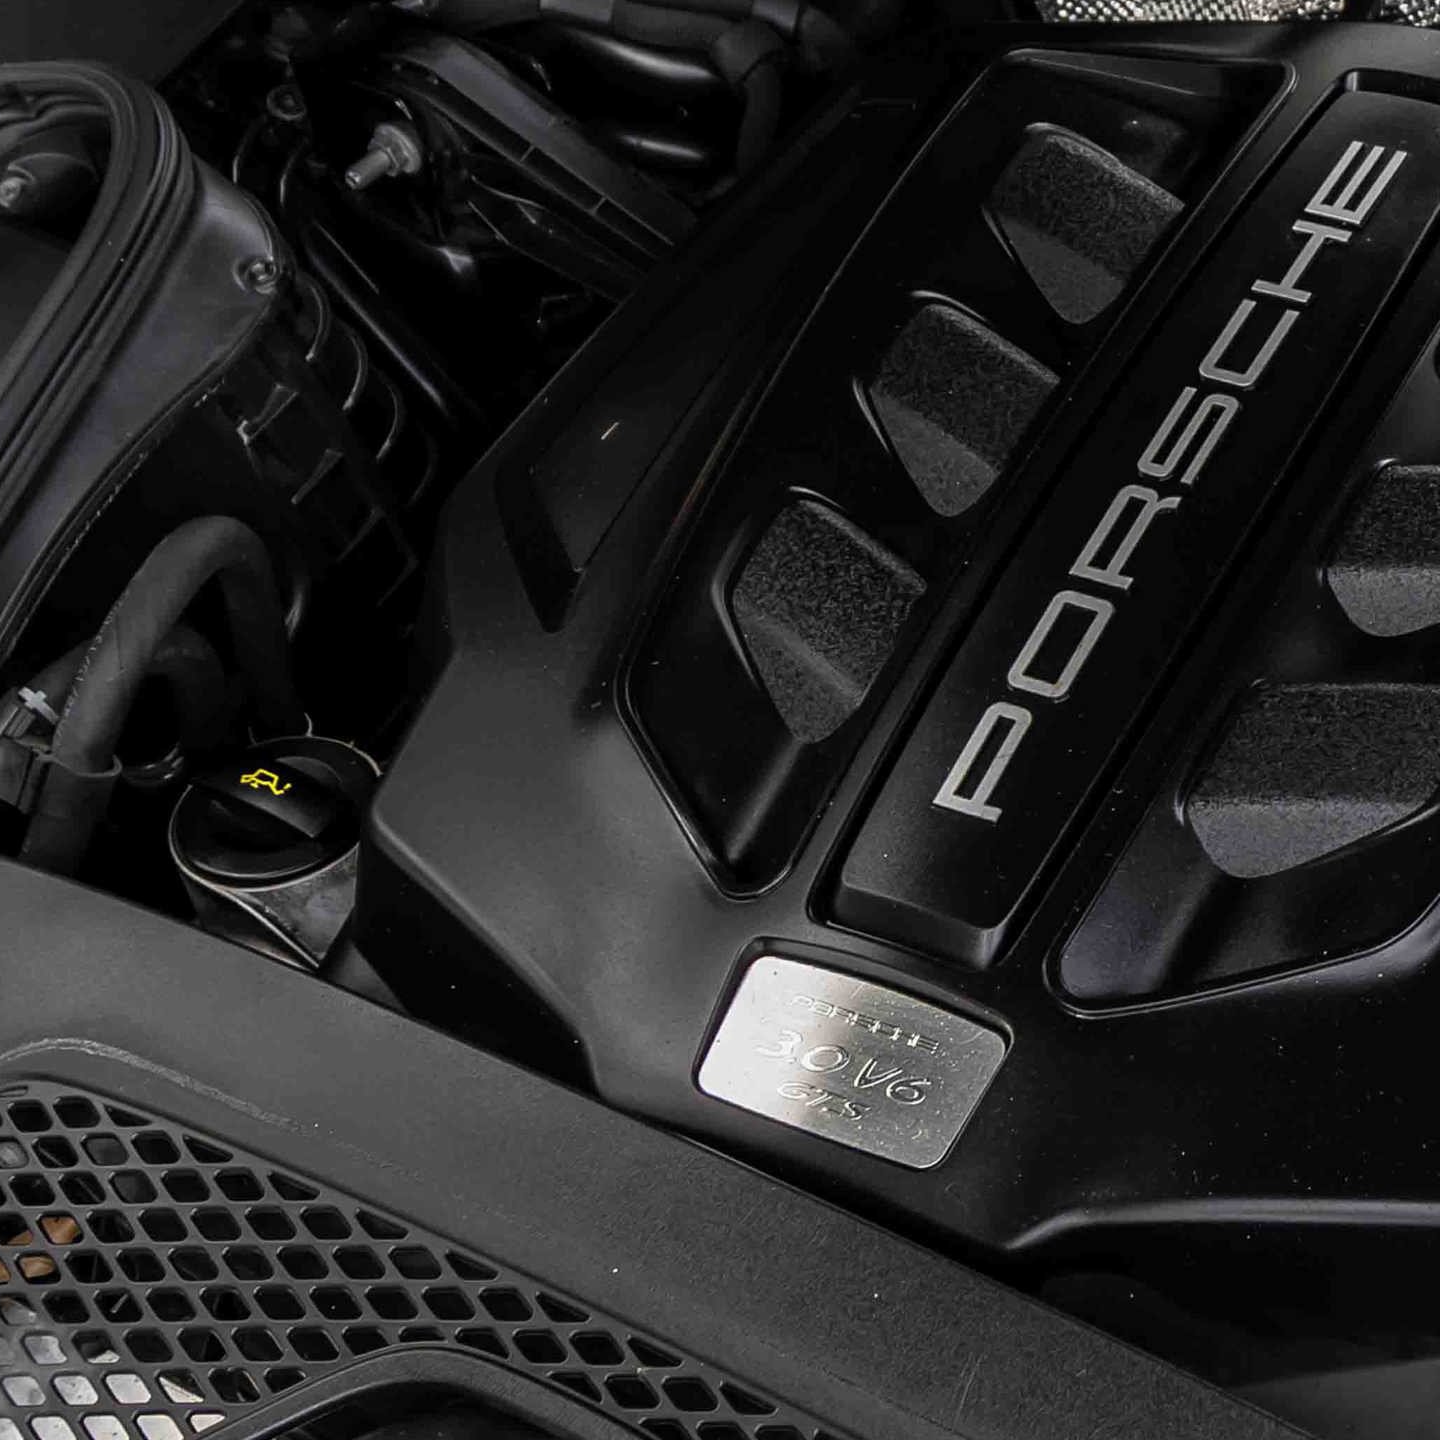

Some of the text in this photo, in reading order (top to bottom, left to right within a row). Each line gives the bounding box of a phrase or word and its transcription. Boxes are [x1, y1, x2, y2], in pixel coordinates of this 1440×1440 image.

[933, 140, 1407, 822] PORSCHE
[789, 995, 939, 1054] PORSCHE
[777, 1080, 871, 1121] GTS
[854, 1057, 931, 1105] V6
